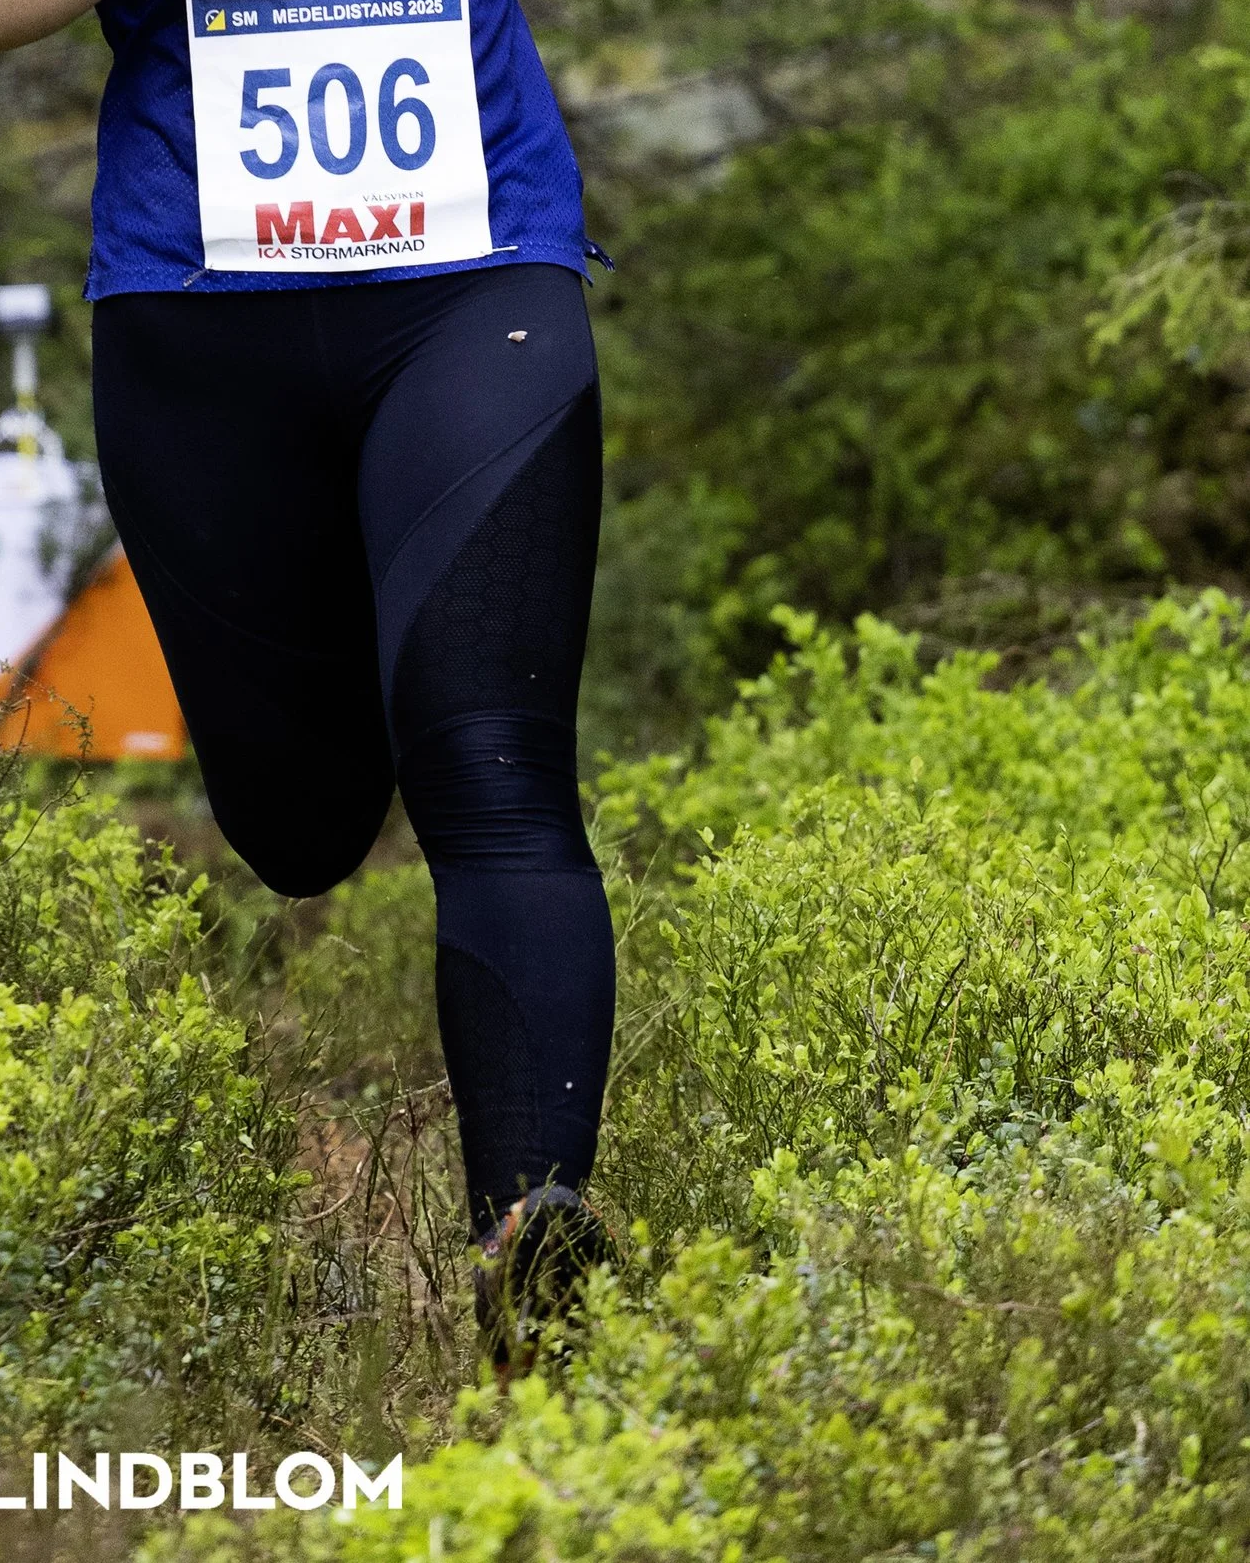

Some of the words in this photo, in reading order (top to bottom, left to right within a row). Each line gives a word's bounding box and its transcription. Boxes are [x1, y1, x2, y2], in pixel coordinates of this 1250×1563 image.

[232, 11, 258, 27] SM
[272, 1, 403, 25] MEDELDISTANS
[407, 0, 444, 16] 2025
[239, 57, 436, 180] 506
[255, 200, 425, 246] MAXI
[258, 246, 286, 259] ICA
[291, 238, 425, 260] STORMARKNAD
